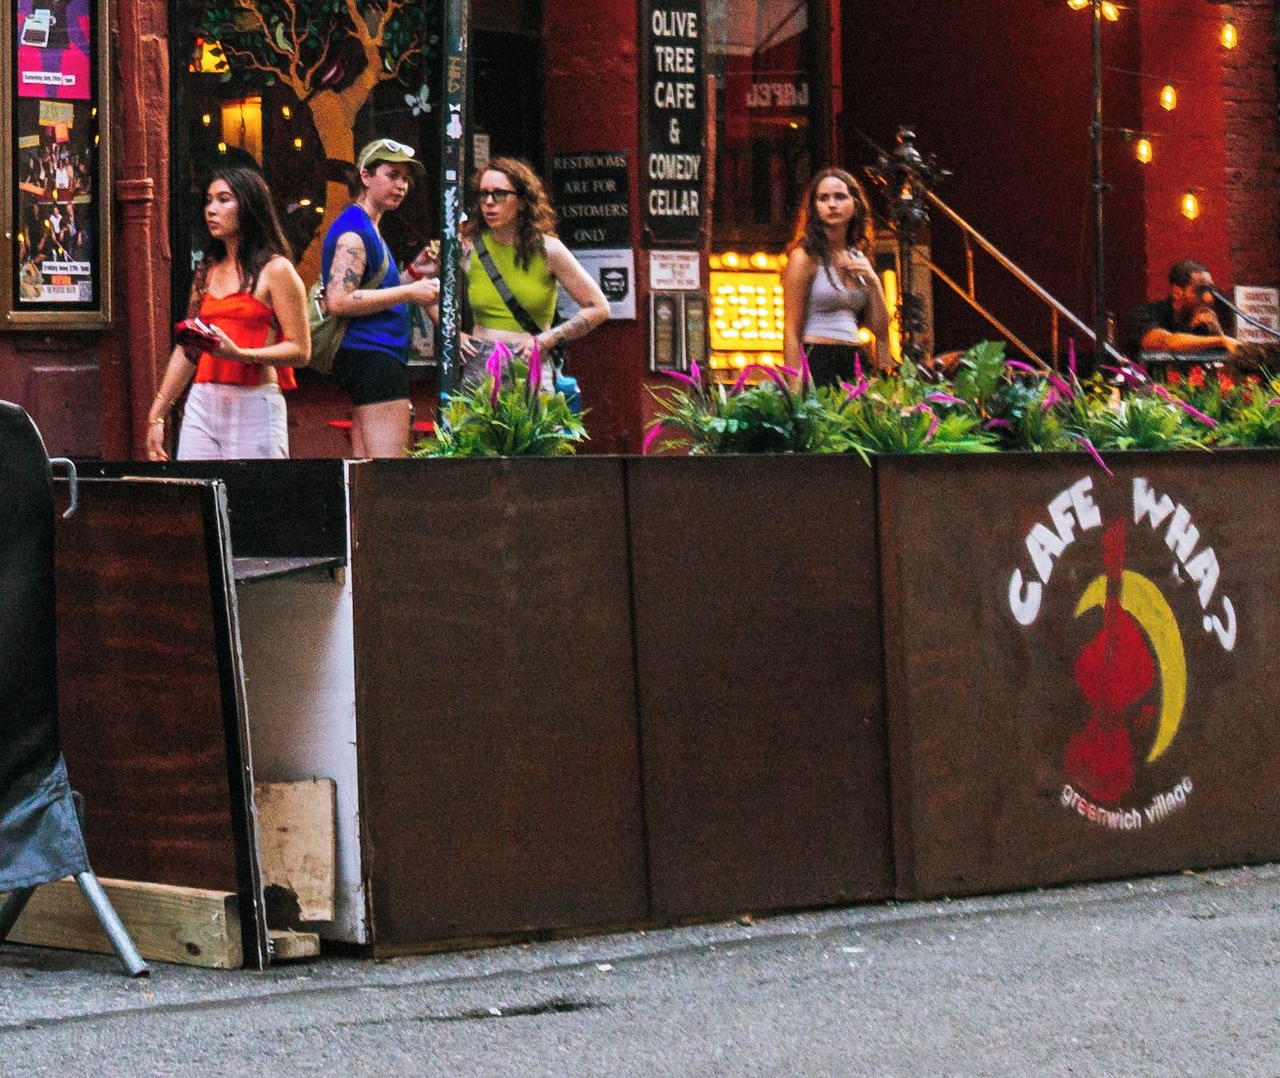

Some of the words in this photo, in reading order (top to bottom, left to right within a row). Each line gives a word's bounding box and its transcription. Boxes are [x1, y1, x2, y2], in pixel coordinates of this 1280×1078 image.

[651, 9, 698, 38] OLIVE
[654, 45, 696, 74] TREE
[653, 81, 696, 109] CAFE
[669, 117, 681, 145] &
[553, 156, 628, 170] RESTROOMS
[648, 152, 701, 181] COMEDY
[563, 181, 590, 194] ARE
[592, 179, 617, 193] FOR
[648, 188, 700, 217] CELLAR
[574, 228, 607, 243] ONLY
[1008, 475, 1102, 626] CAFE
[1132, 476, 1237, 652] WHA?
[1060, 783, 1142, 830] greenwich
